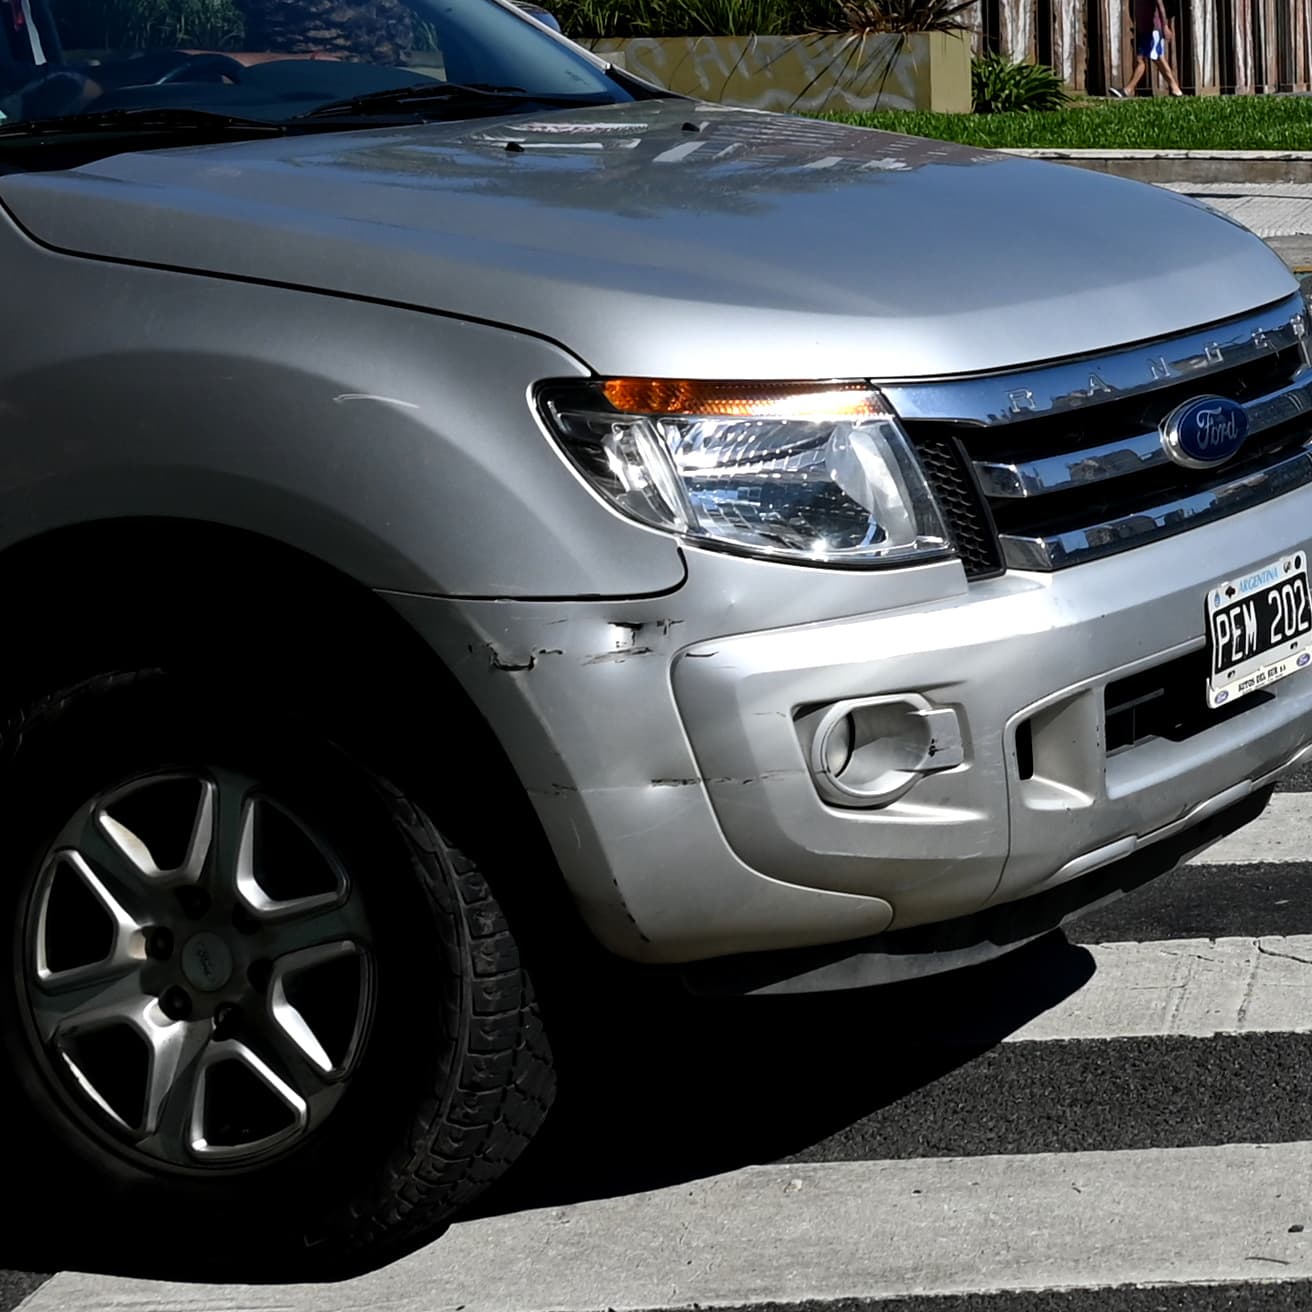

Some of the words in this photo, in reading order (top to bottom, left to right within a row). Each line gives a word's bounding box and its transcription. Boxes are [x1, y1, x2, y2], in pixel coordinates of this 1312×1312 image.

[1008, 314, 1306, 414] RANGER
[1196, 406, 1239, 450] Ford
[1240, 567, 1280, 593] ARGENTINA
[1216, 600, 1257, 669] PEM
[1268, 579, 1309, 644] 202
